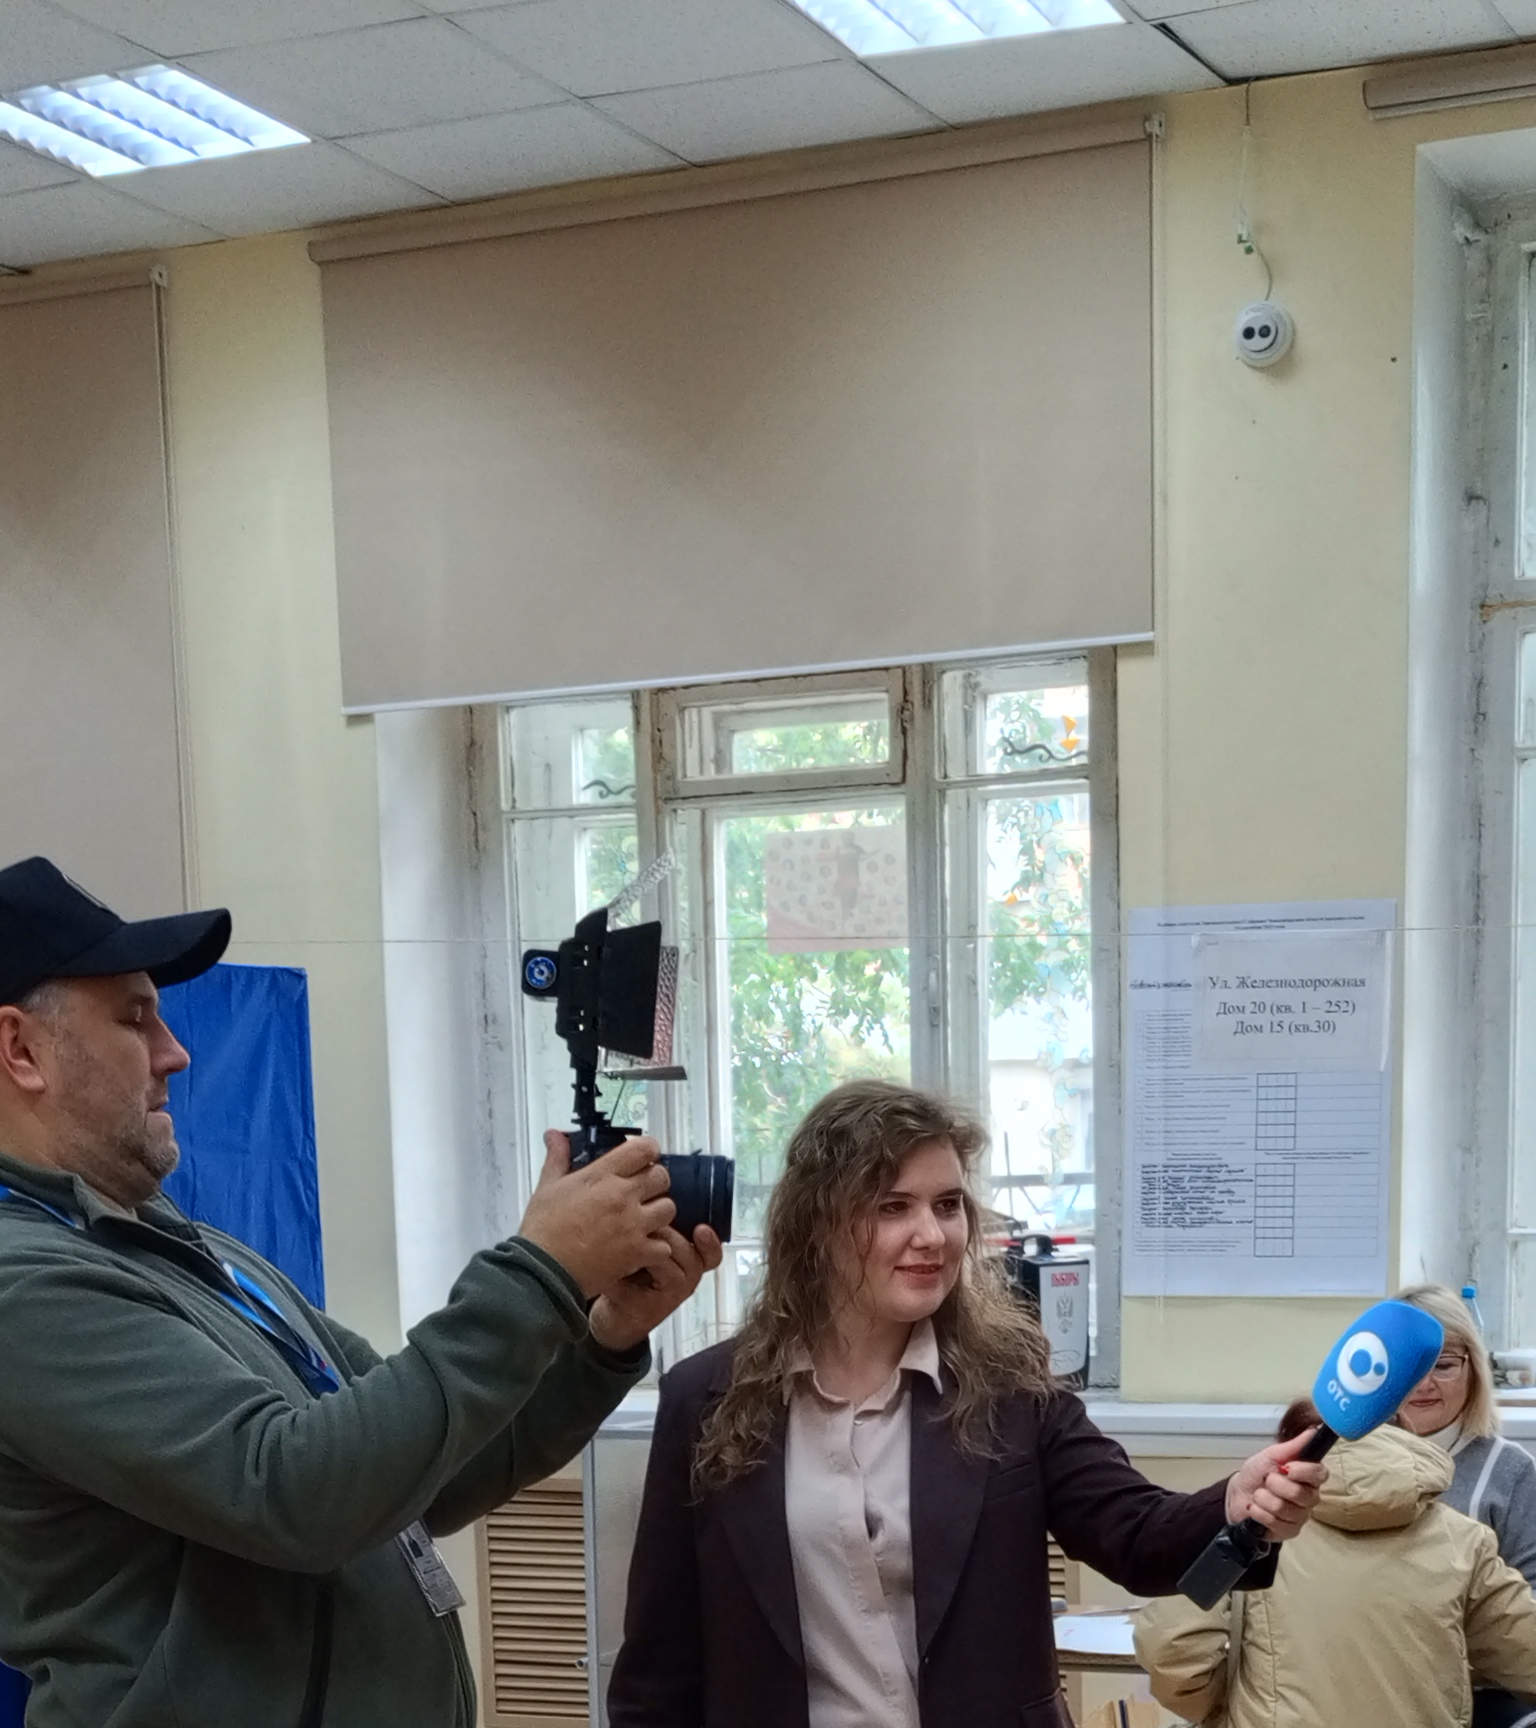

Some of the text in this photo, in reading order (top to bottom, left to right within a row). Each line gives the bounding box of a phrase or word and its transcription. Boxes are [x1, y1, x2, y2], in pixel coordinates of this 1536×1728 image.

[1208, 976, 1231, 989] Ул.
[1236, 975, 1366, 991] Железнодорожная
[1216, 1002, 1246, 1016] Дом
[1250, 1002, 1266, 1014] 20
[1270, 1001, 1295, 1016] (кв.
[1324, 1000, 1356, 1015] 252)
[1233, 1019, 1336, 1035] Дом 15 (кв.30)
